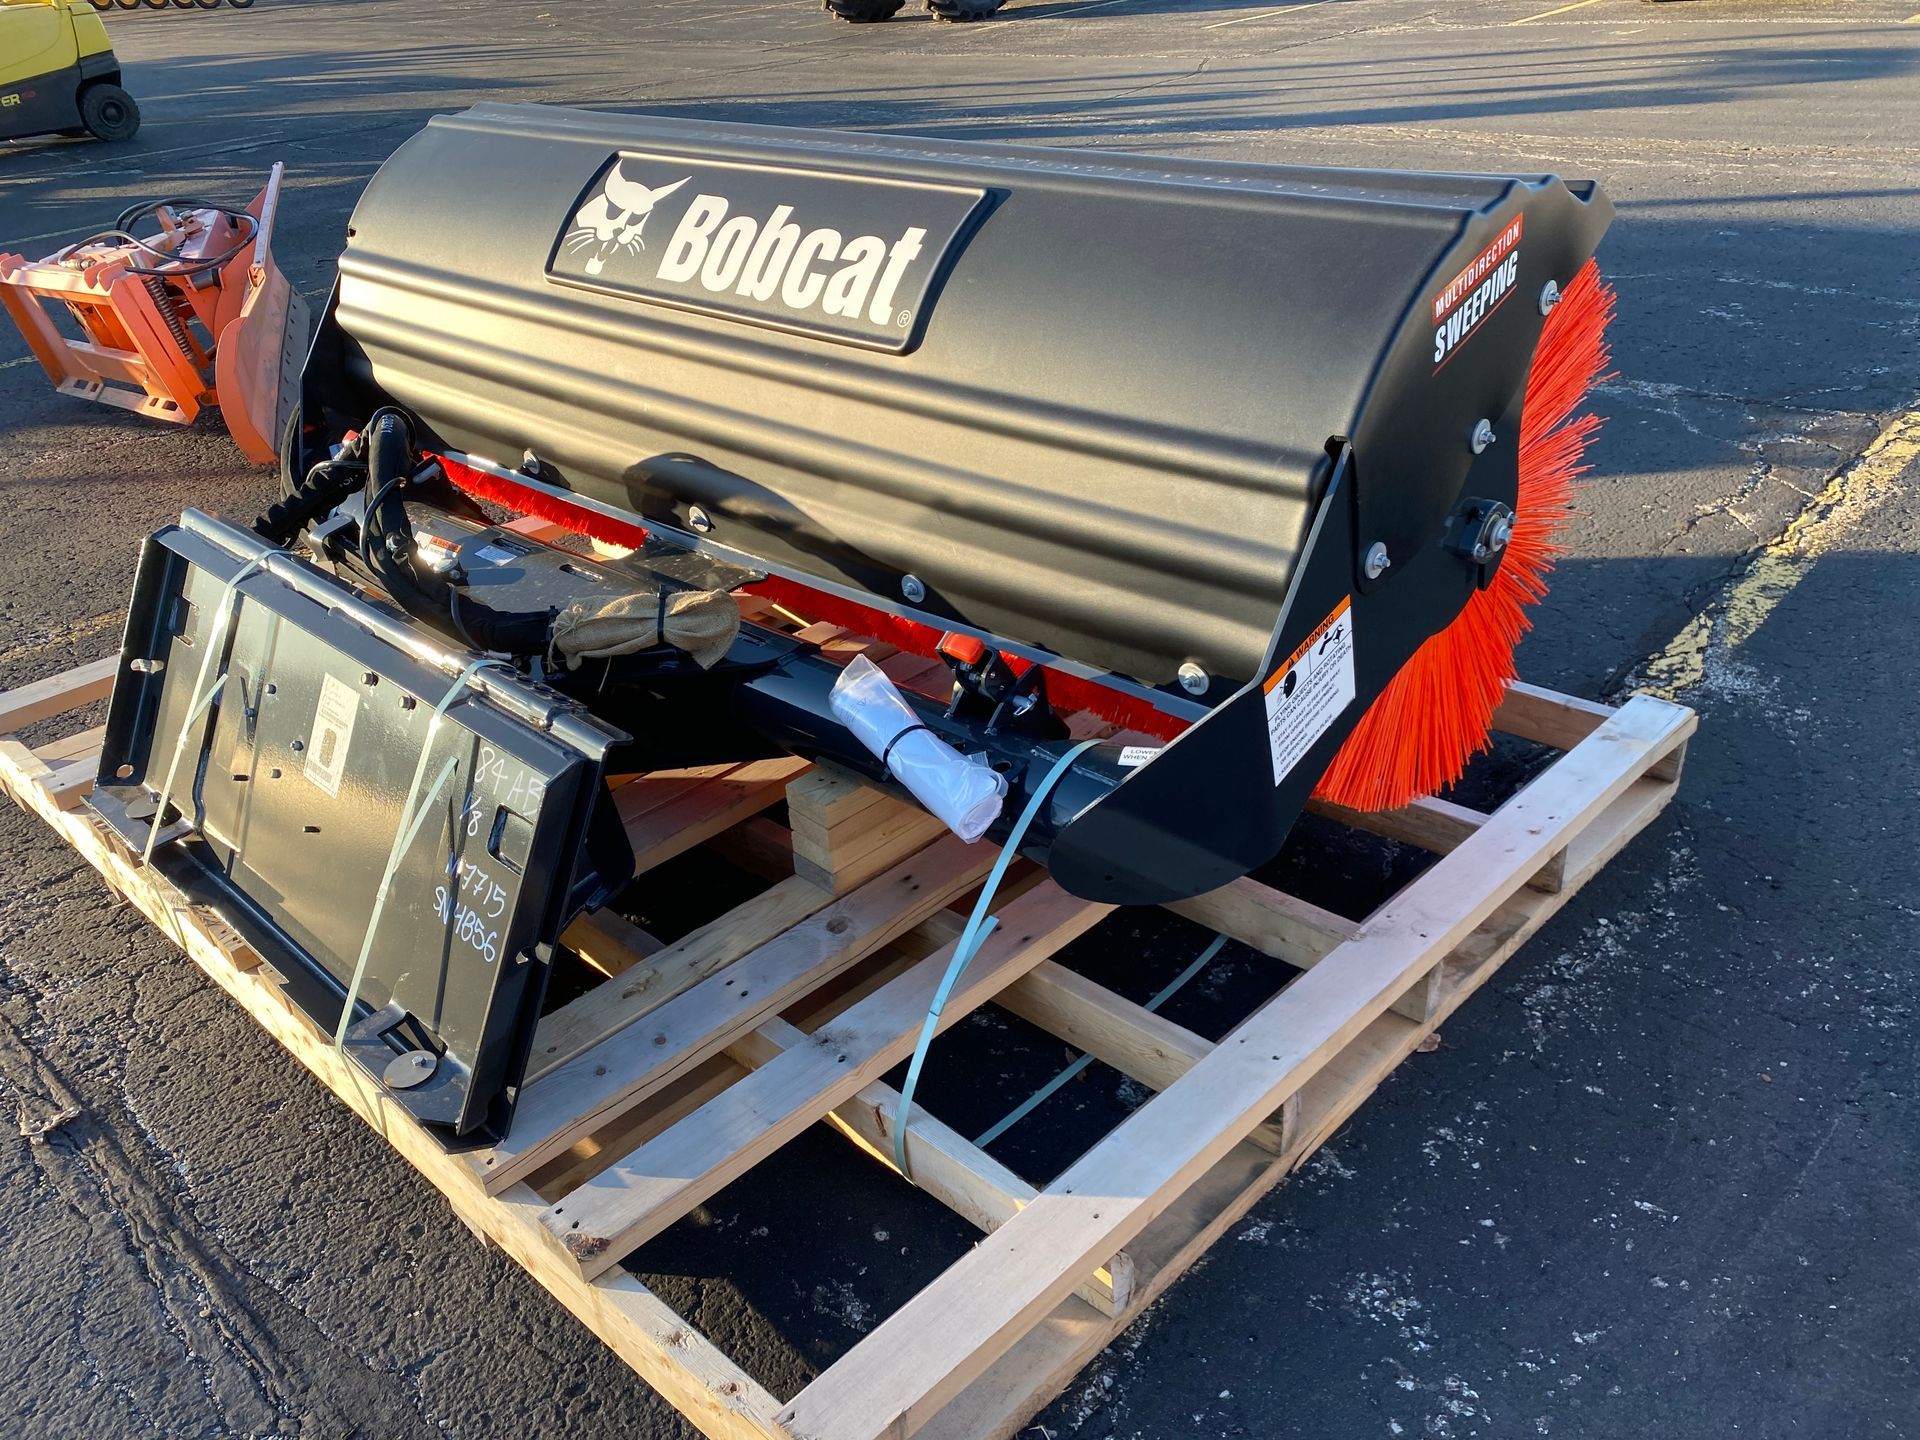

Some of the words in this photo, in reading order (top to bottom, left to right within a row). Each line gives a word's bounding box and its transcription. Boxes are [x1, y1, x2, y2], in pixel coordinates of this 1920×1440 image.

[656, 193, 928, 325] Bobcat
[1434, 250, 1518, 363] SWEEPING
[1435, 221, 1520, 318] MULTIDIRECTION
[1296, 613, 1334, 660] WARNING
